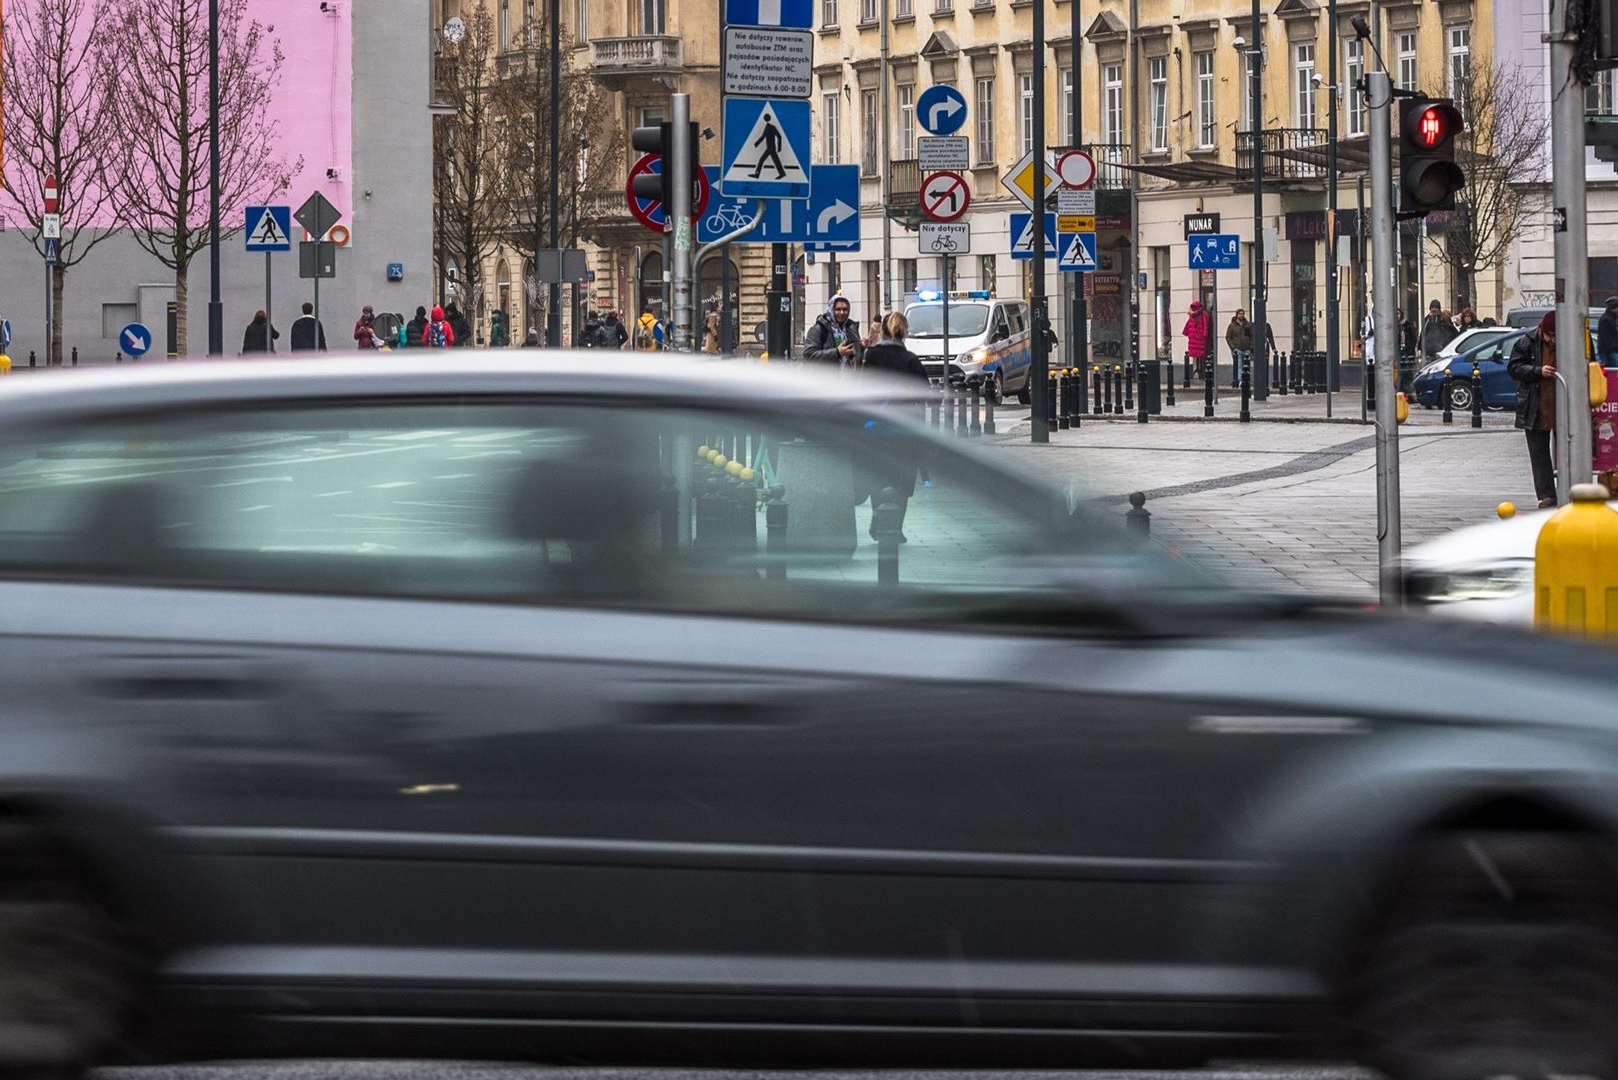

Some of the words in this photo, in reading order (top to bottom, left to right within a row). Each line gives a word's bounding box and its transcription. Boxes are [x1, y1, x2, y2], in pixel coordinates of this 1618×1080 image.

[749, 33, 773, 43] dotyczy
[735, 43, 772, 51] autobusów
[728, 53, 760, 61] pojazdów
[740, 63, 783, 72] identyfikator
[727, 72, 738, 80] Nie
[740, 73, 765, 82] dotyczy
[767, 75, 810, 84] zaopatrzenia
[737, 83, 772, 91] godzinach
[1188, 218, 1213, 231] NUNAR
[937, 225, 966, 233] dotyczy
